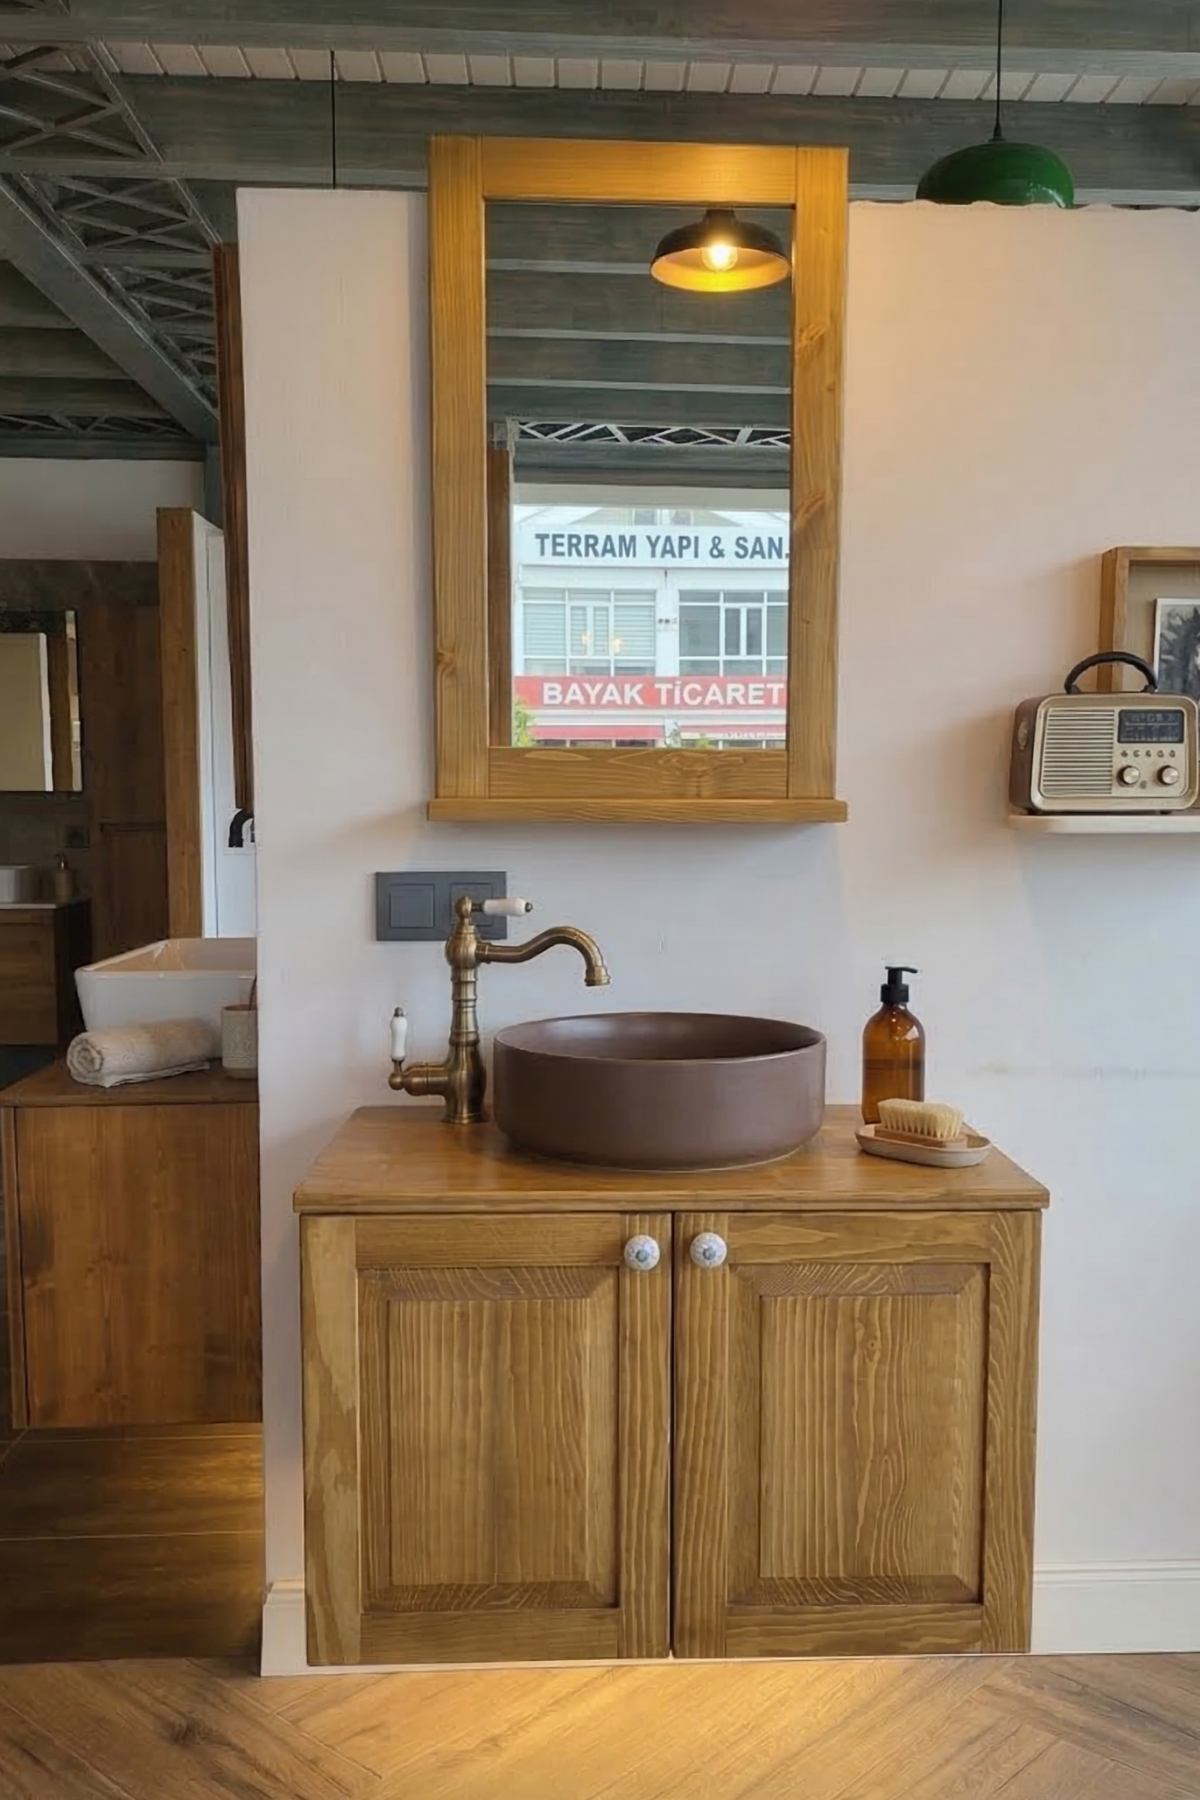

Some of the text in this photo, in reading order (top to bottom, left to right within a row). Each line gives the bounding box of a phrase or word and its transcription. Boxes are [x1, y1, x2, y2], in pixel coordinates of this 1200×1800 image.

[535, 533, 637, 558] TERRAM
[645, 535, 700, 558] YAPI
[708, 535, 726, 559] &
[542, 682, 644, 705] BAYAK
